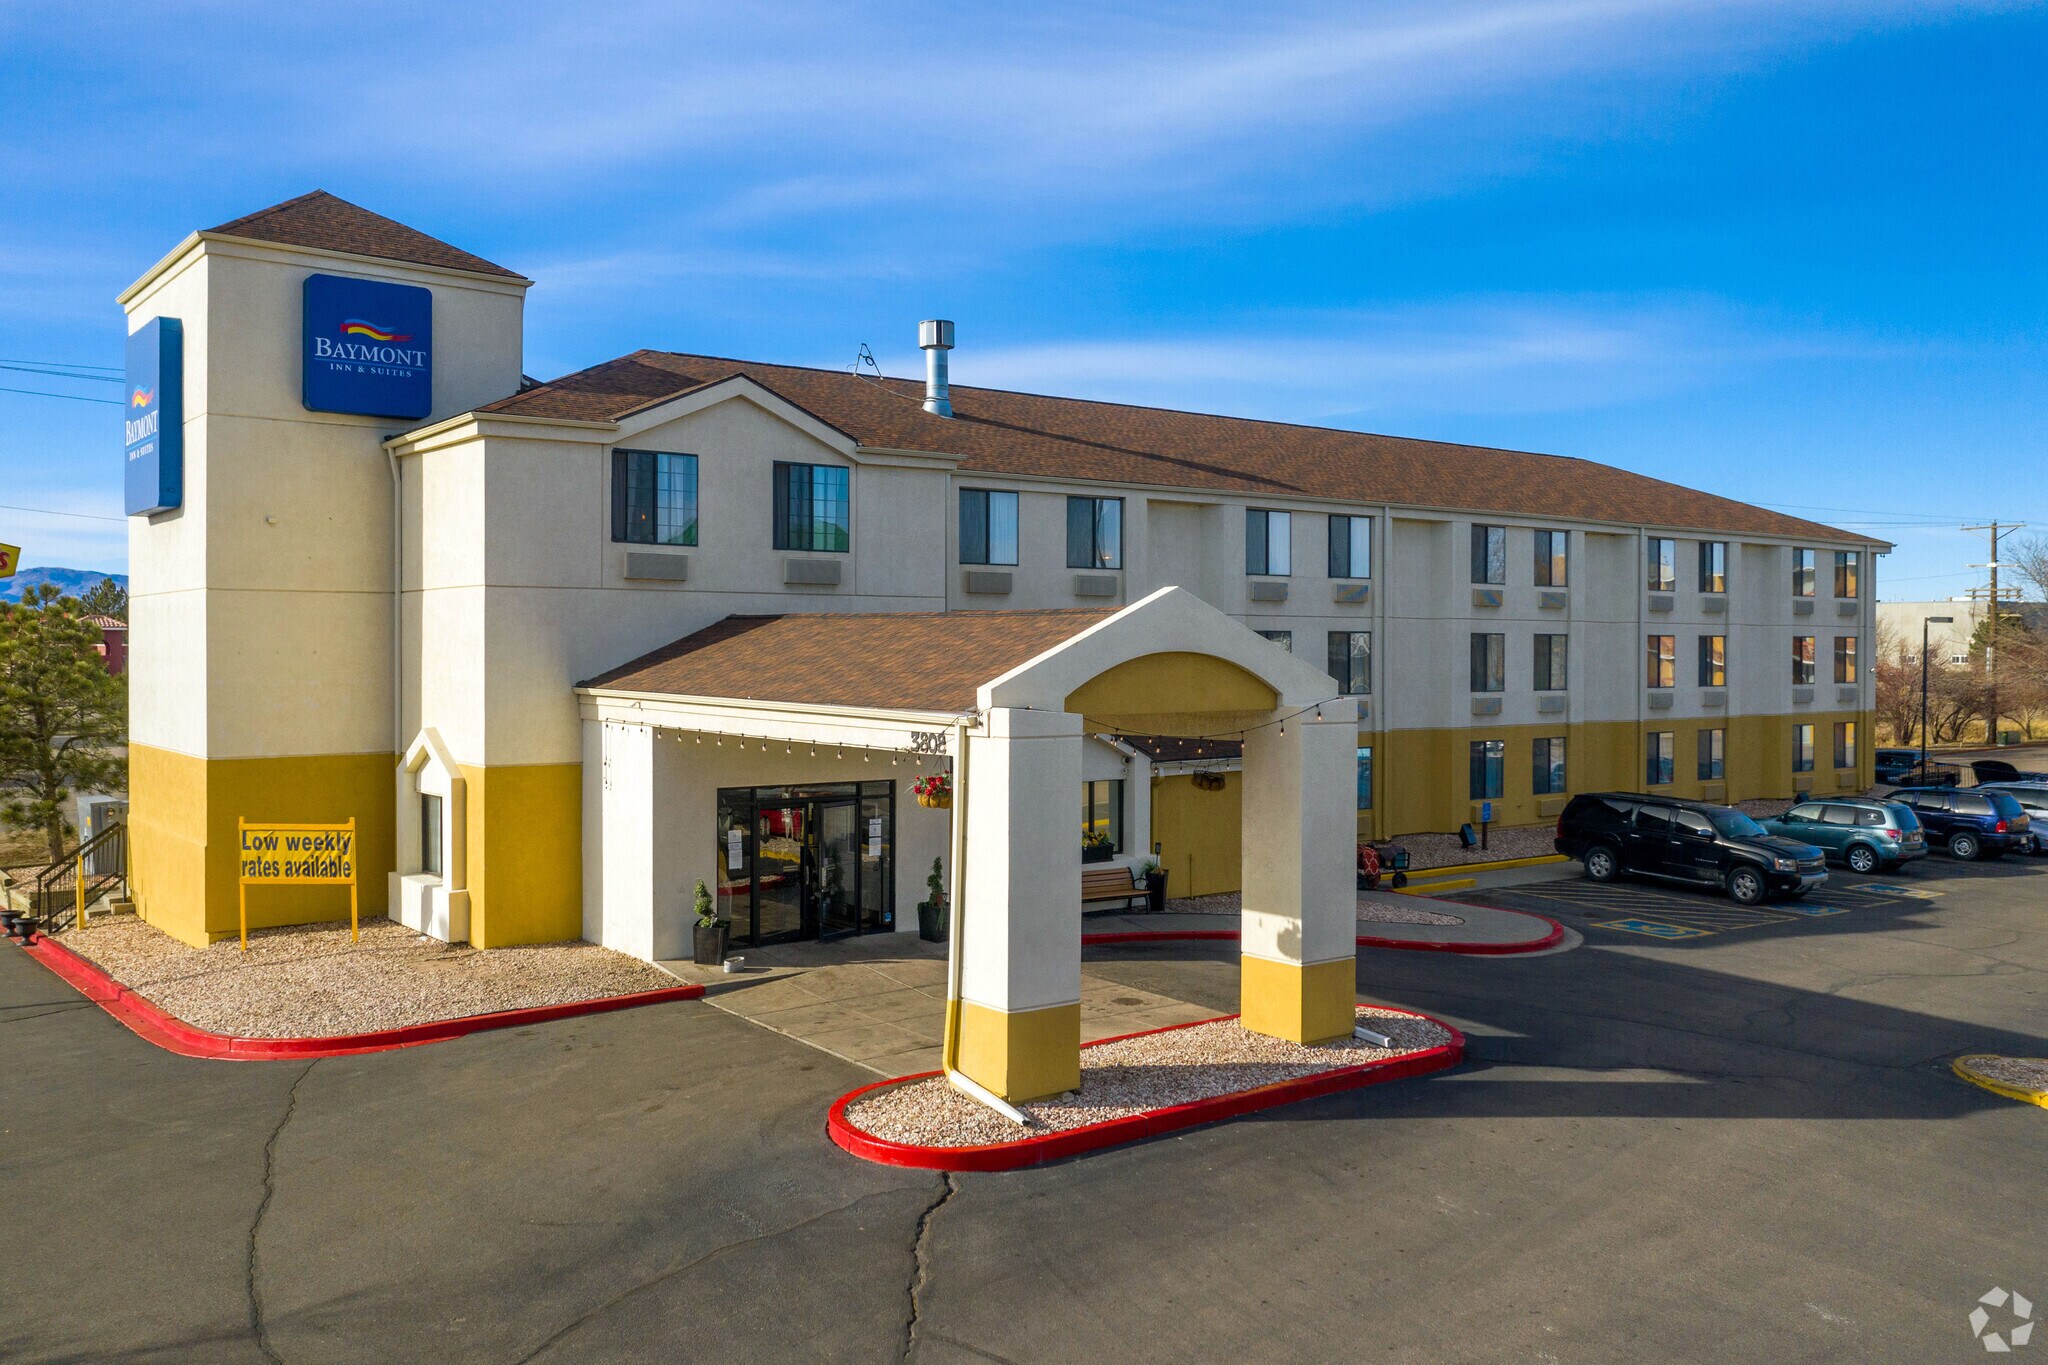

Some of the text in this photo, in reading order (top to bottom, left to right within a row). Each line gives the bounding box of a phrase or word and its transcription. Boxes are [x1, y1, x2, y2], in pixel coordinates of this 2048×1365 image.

[314, 336, 427, 367] BAYMONT
[330, 363, 412, 377] INN & SUITES
[126, 410, 158, 446] BAYMONT
[911, 731, 946, 754] 3808
[242, 831, 352, 856] Low weekly
[242, 855, 351, 878] rates available
